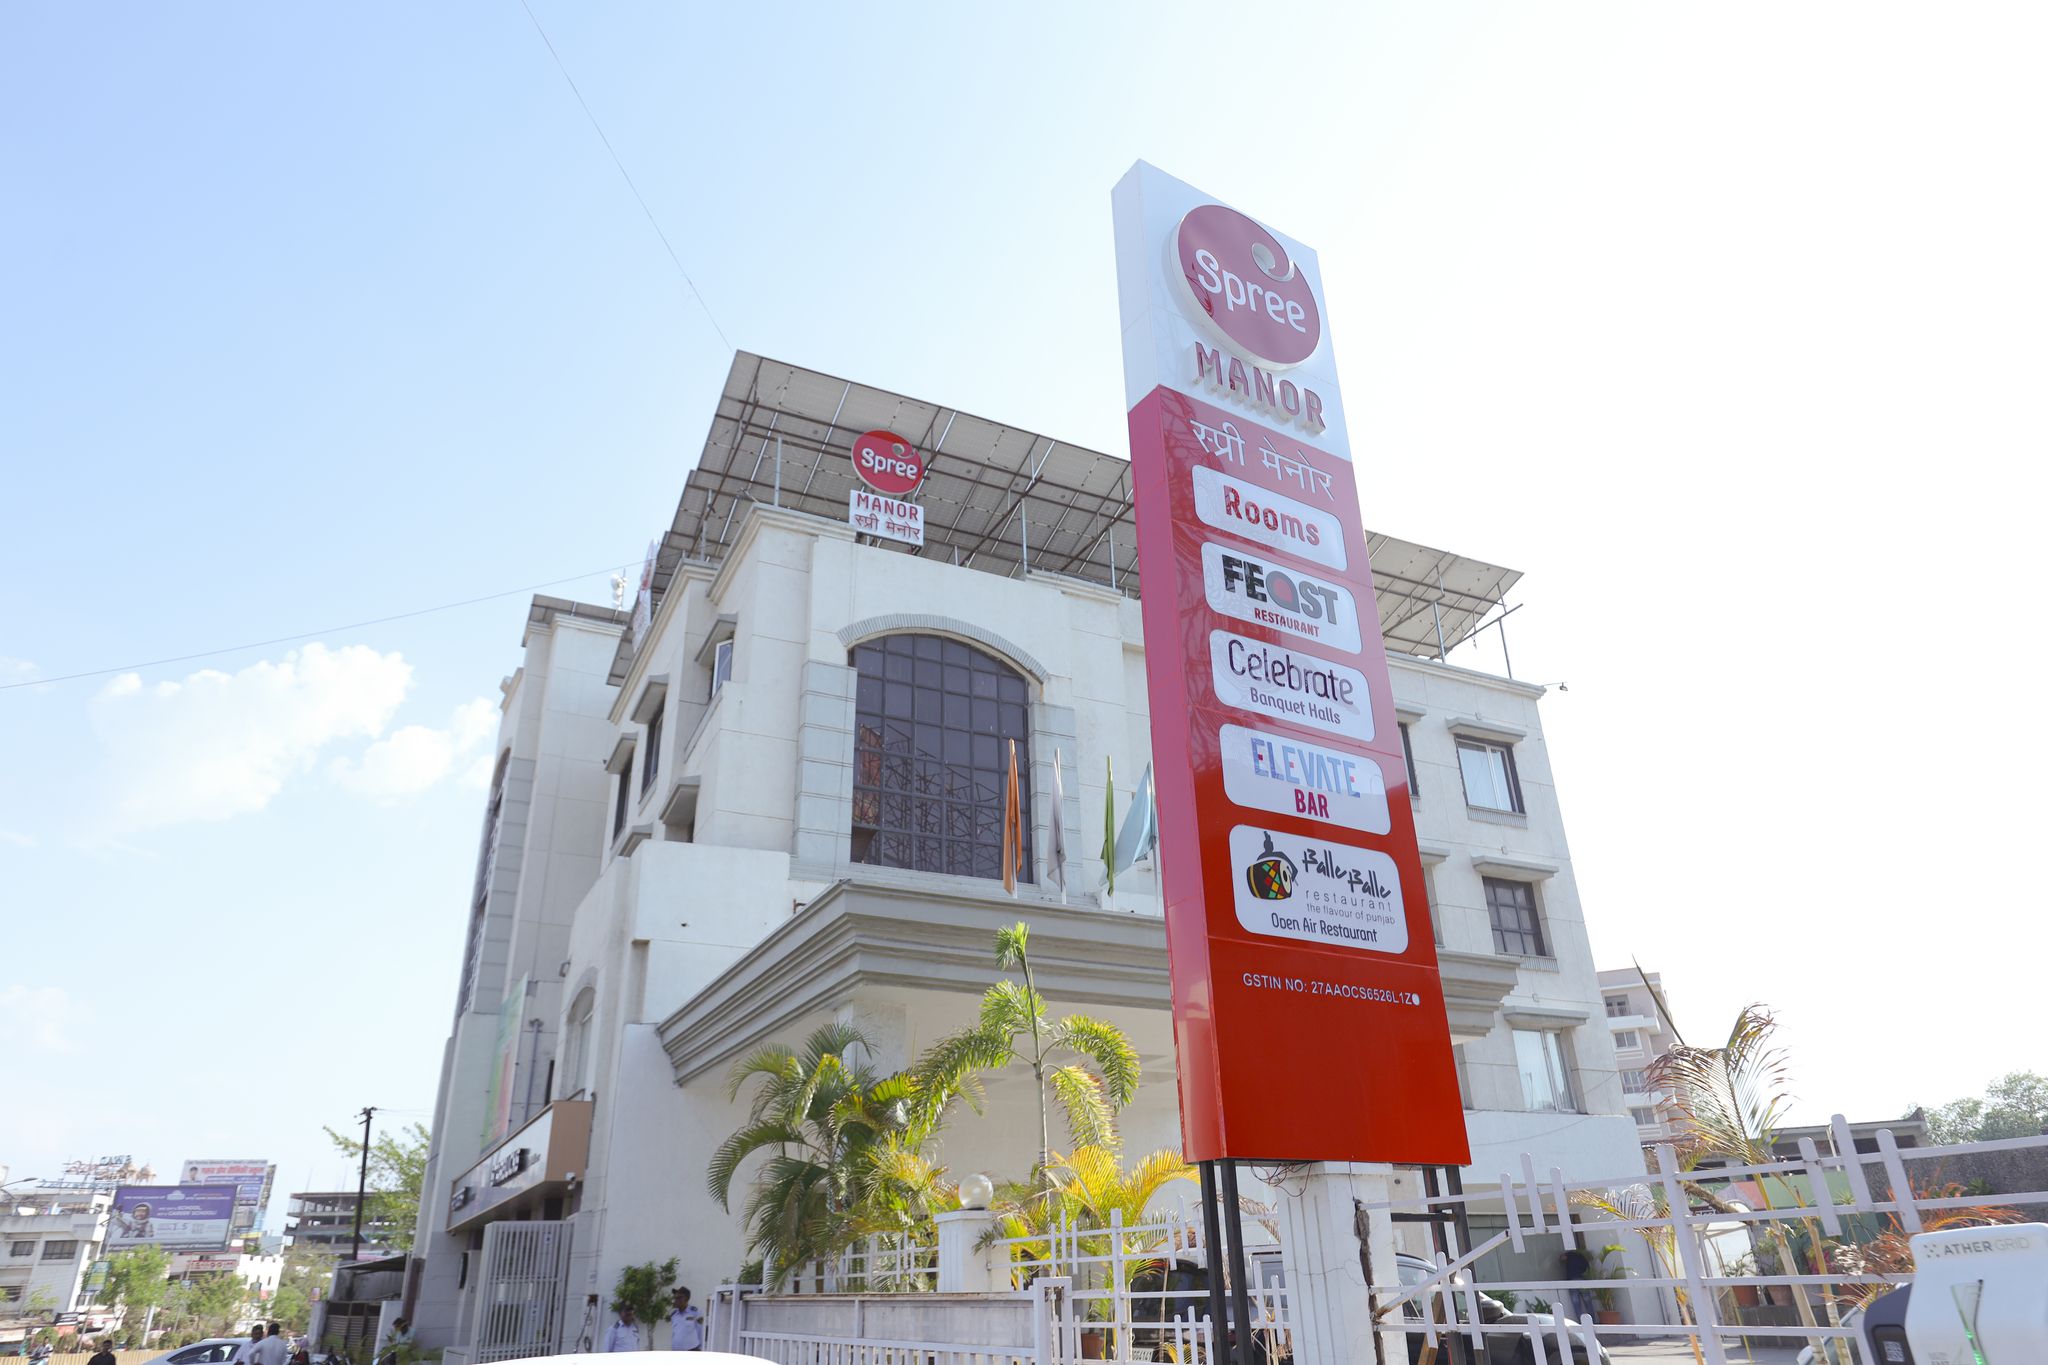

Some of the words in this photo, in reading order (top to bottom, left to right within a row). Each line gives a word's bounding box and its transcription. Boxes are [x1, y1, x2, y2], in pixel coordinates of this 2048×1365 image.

[1194, 248, 1306, 333] Spree
[1195, 341, 1326, 431] MANOR
[861, 448, 918, 480] Spree
[1189, 418, 1246, 466] स्प्री
[1259, 435, 1335, 501] मेनोर
[857, 493, 918, 521] MANOR
[1223, 484, 1321, 547] Rooms
[886, 518, 920, 540] मेनोर
[1221, 554, 1339, 625] FEAST
[1254, 606, 1320, 638] RESTAURANT
[1228, 639, 1355, 707] Celebrate
[1250, 687, 1306, 718] Banquet
[1308, 700, 1341, 725] Halls
[1250, 737, 1361, 799] ELEVATE
[1294, 788, 1330, 819] BAR
[1302, 848, 1348, 880] Balle
[1347, 868, 1392, 899] Balle
[1305, 889, 1392, 913] restaurant
[1306, 903, 1321, 914] the
[1323, 906, 1353, 919] flavour
[1355, 909, 1364, 921] of
[1366, 912, 1396, 926] punjab
[1303, 917, 1318, 934] Air
[1319, 920, 1378, 943] Restaurant
[1242, 972, 1282, 991] GSTIN
[1285, 977, 1309, 993] NO:
[1943, 1240, 1993, 1256] ATHER
[1995, 1237, 2030, 1251] GRID
